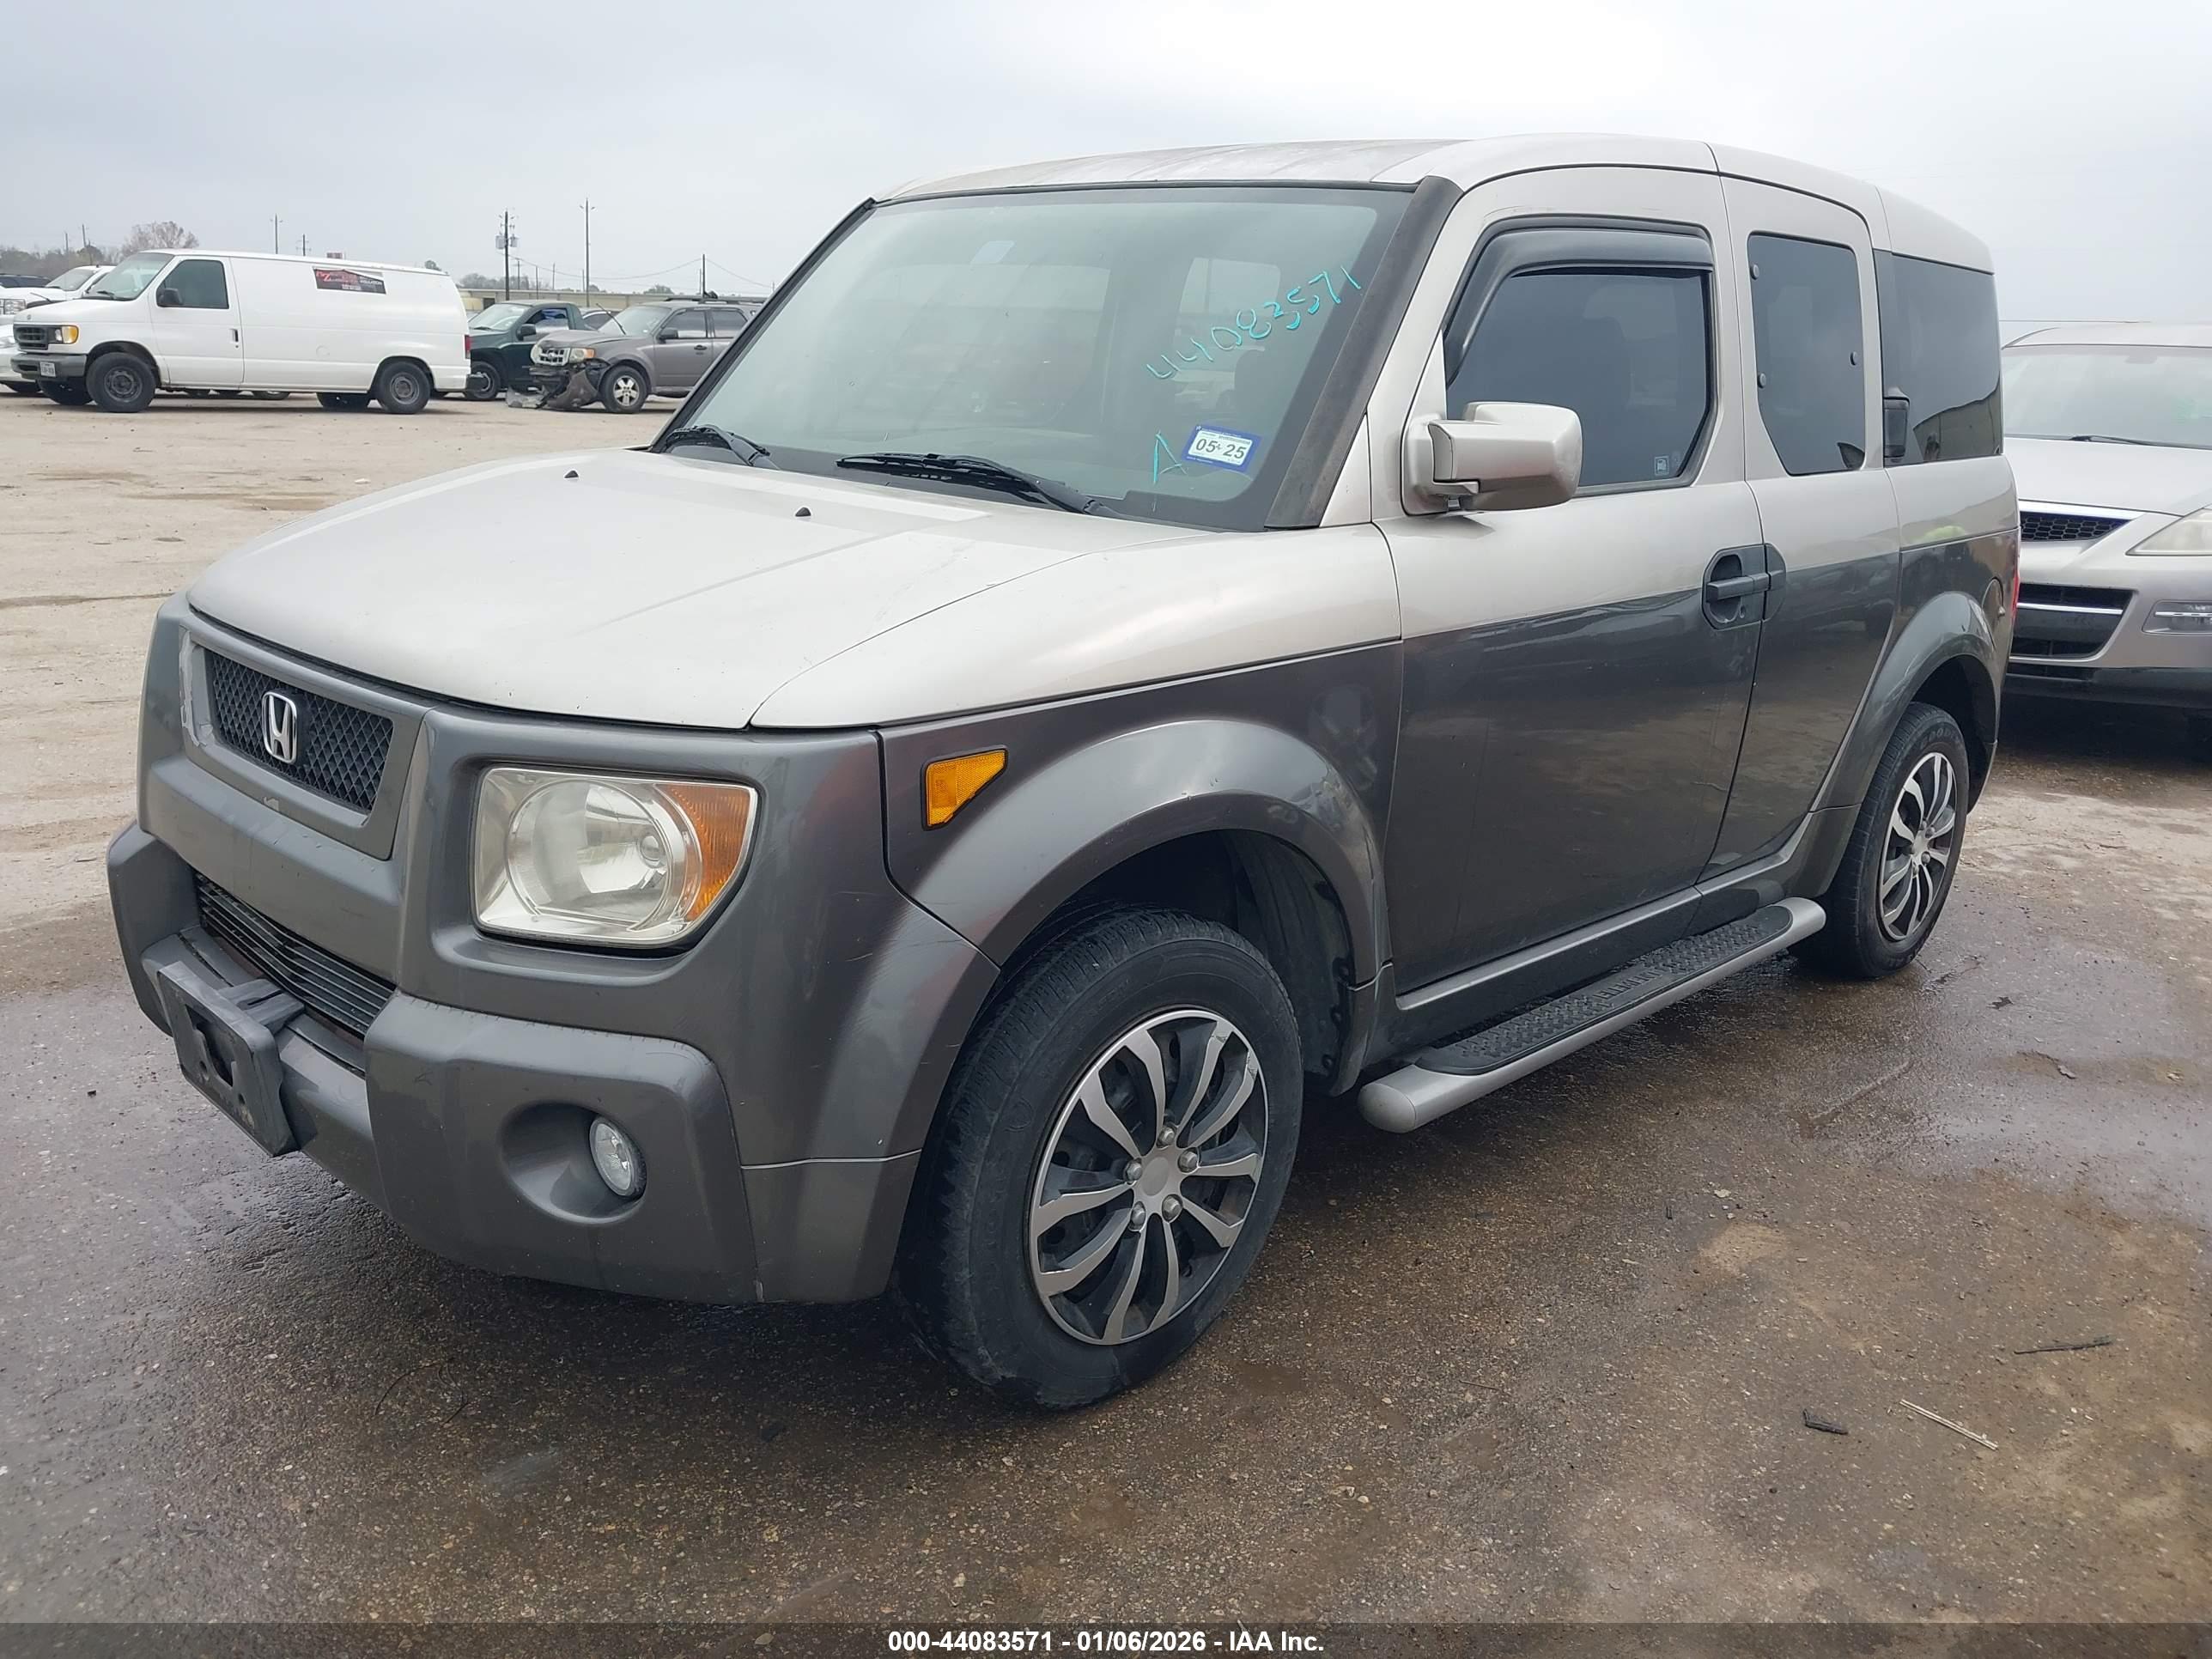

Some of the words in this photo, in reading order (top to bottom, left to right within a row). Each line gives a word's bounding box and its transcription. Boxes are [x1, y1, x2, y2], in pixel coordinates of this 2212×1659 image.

[1146, 264, 1362, 380] 44083571
[1195, 438, 1218, 453] 05
[1222, 443, 1247, 459] 25
